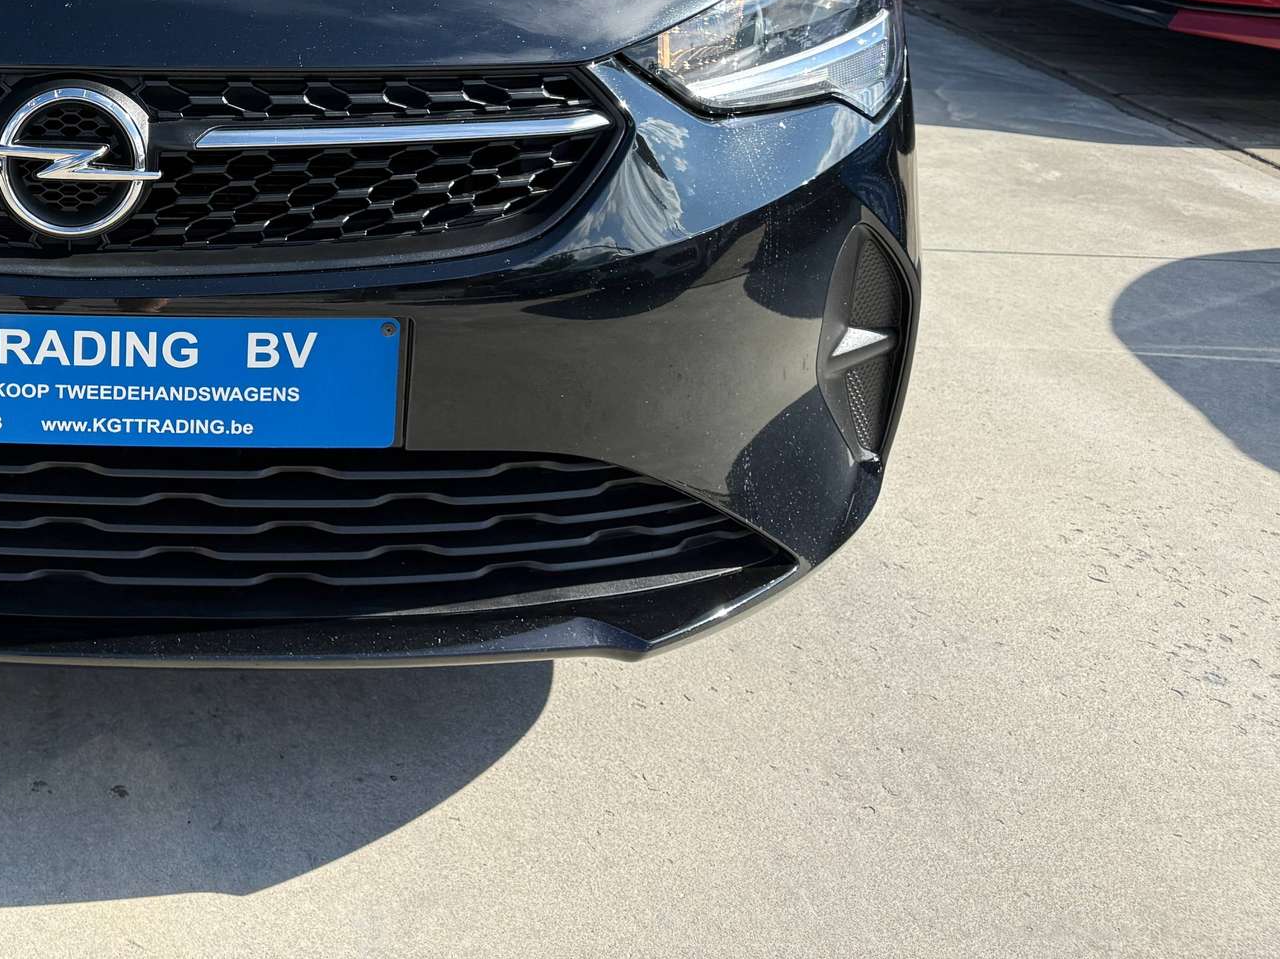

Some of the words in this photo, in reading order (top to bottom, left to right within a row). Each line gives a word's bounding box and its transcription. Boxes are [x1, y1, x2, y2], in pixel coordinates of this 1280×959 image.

[246, 332, 318, 369] BV
[55, 384, 300, 402] TWEEDEHANDSWAGENS
[41, 417, 254, 435] www.KGTTRADING.be
